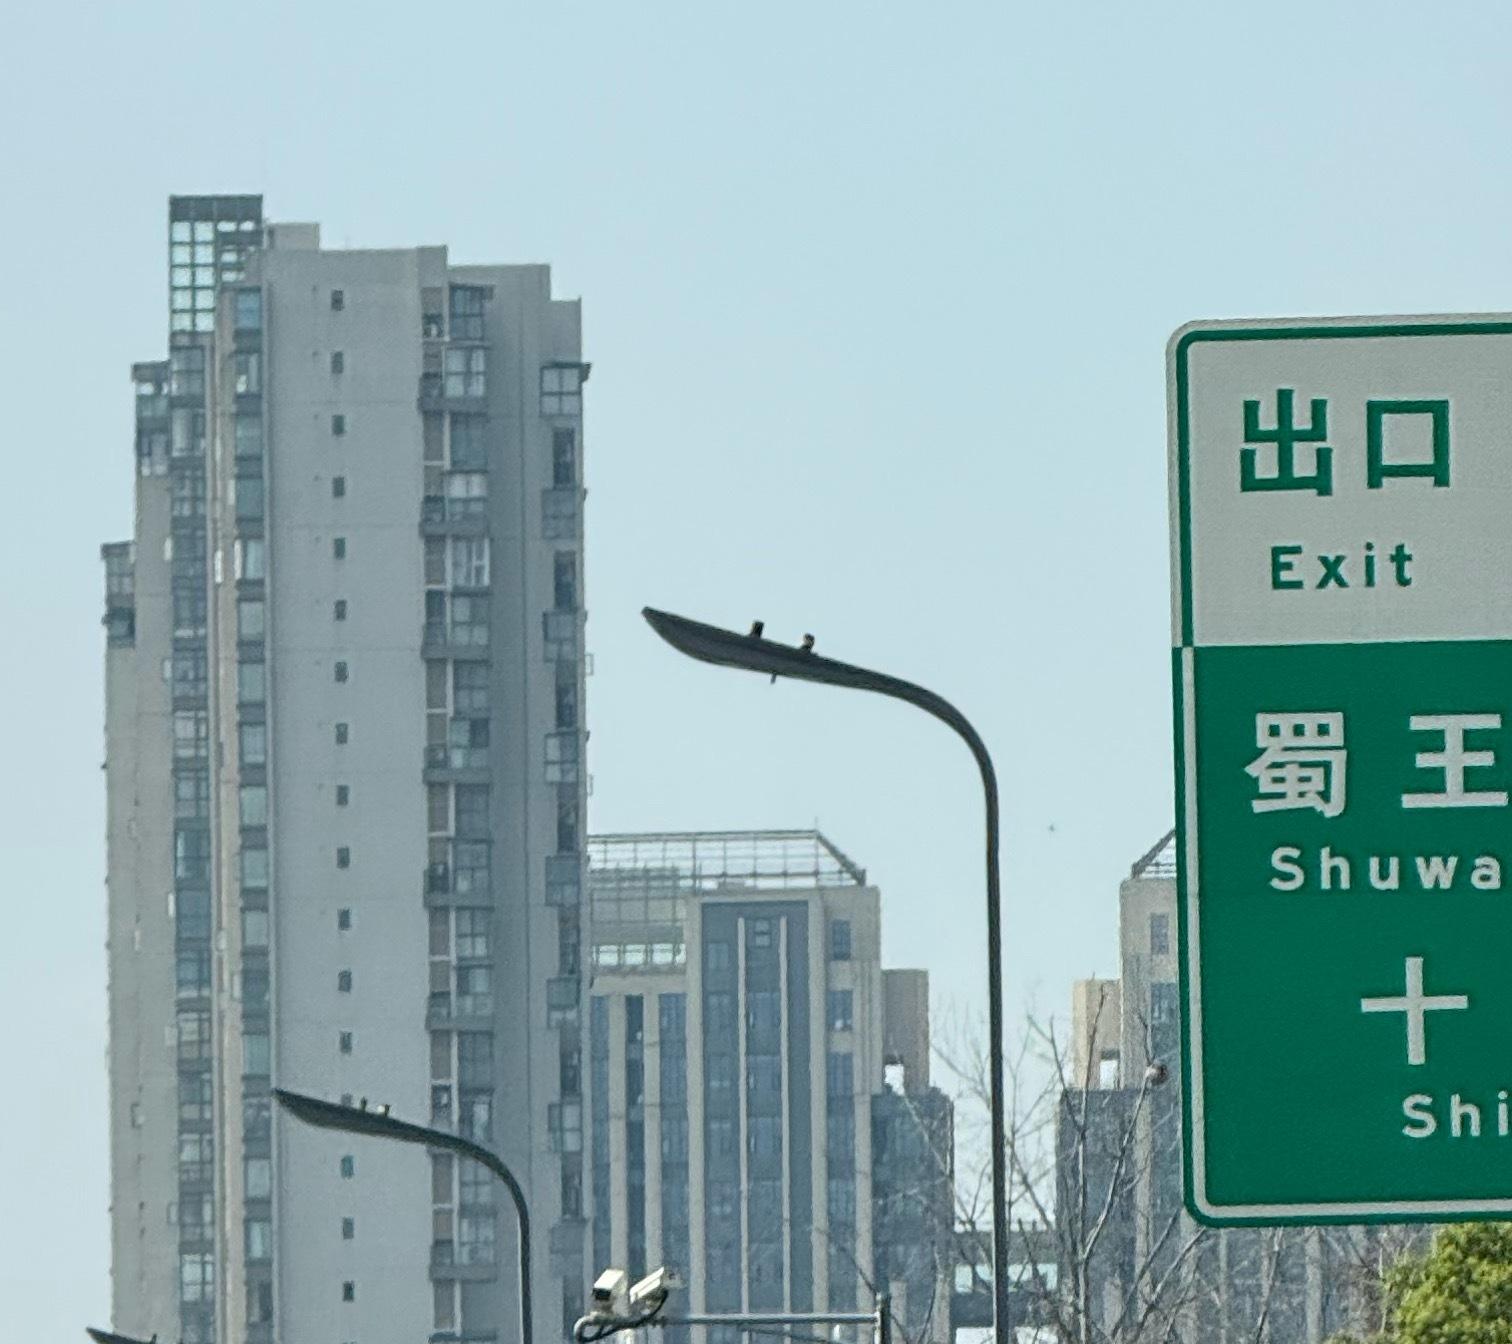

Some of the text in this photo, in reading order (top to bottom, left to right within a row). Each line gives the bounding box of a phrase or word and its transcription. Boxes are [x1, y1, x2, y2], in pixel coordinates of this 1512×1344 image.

[1239, 388, 1451, 497] 出口
[1270, 541, 1413, 591] Exit
[1244, 711, 1510, 818] 蜀王
[1270, 846, 1502, 891] Shuwa
[1360, 956, 1469, 1066] 十
[1402, 1090, 1510, 1138] Shi
